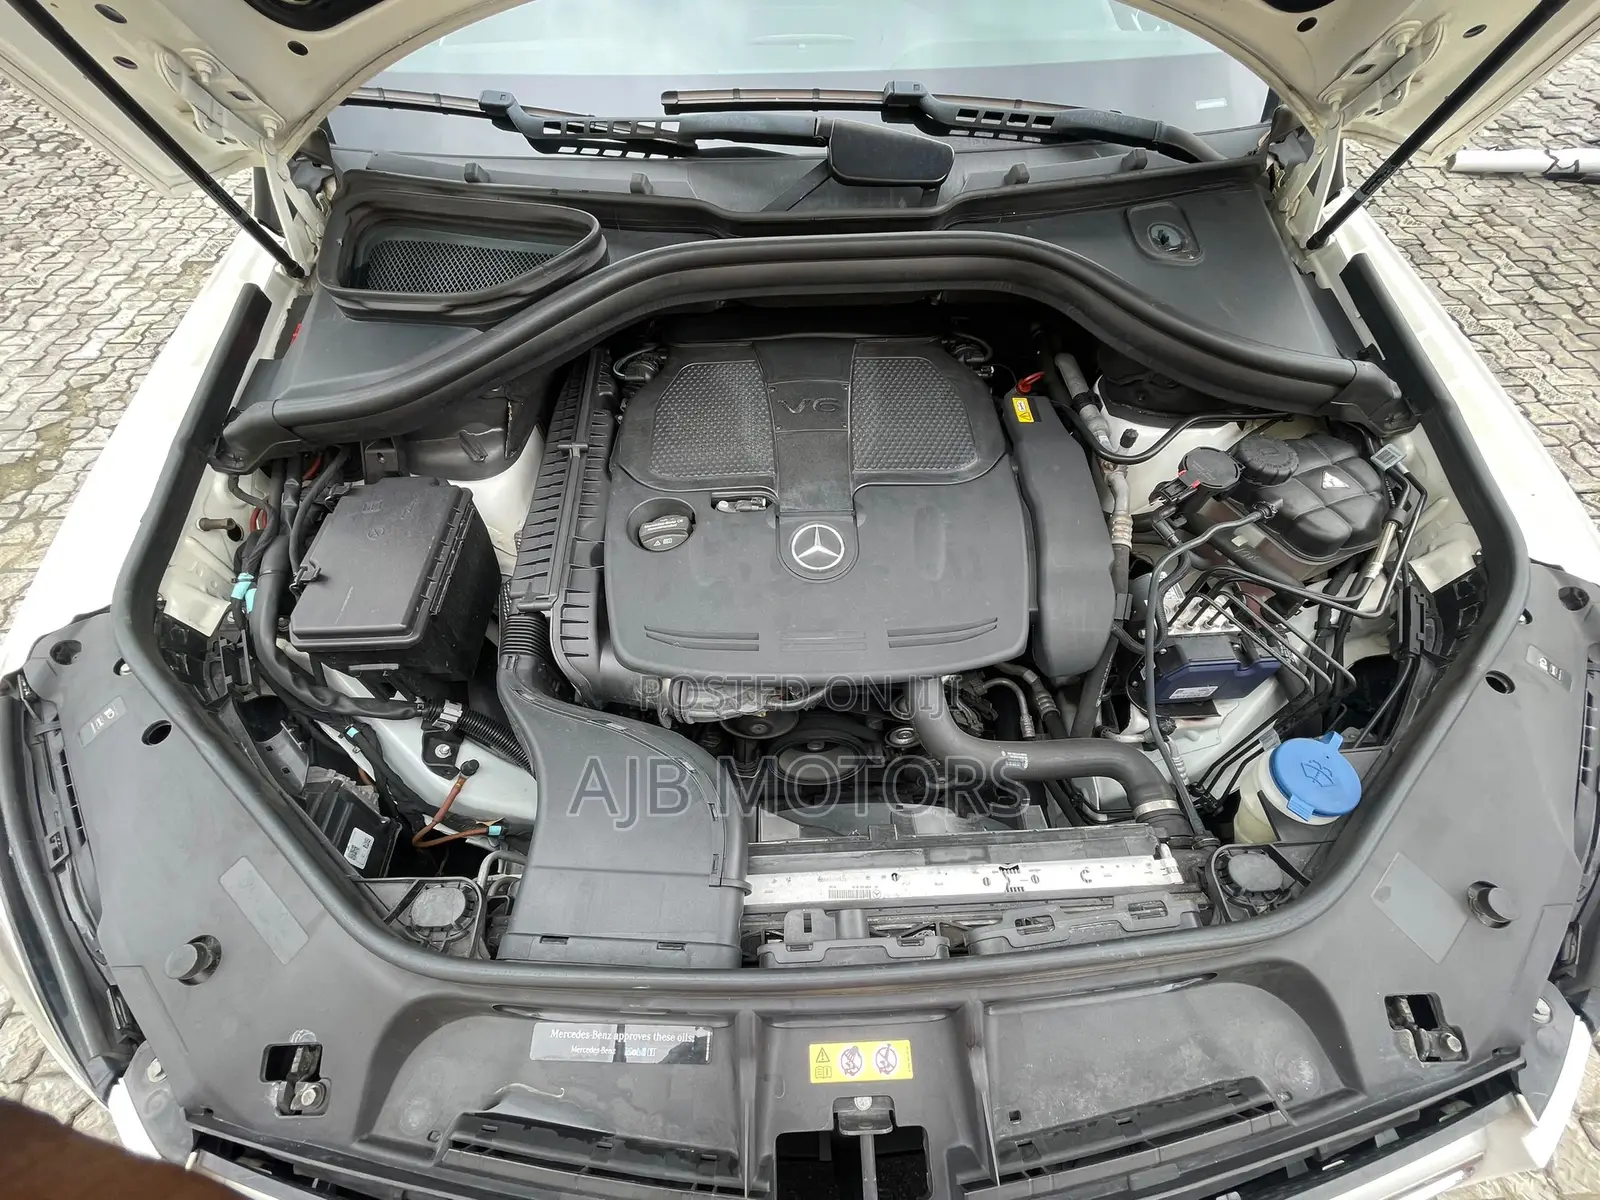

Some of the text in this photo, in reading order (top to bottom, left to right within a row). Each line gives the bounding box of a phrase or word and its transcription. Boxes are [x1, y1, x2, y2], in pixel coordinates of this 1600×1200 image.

[777, 397, 841, 413] V6
[549, 1028, 612, 1040] Mercedes-Benz
[613, 1032, 651, 1043] approves
[652, 1031, 676, 1042] these
[570, 1045, 616, 1055] Mercedes-Benz
